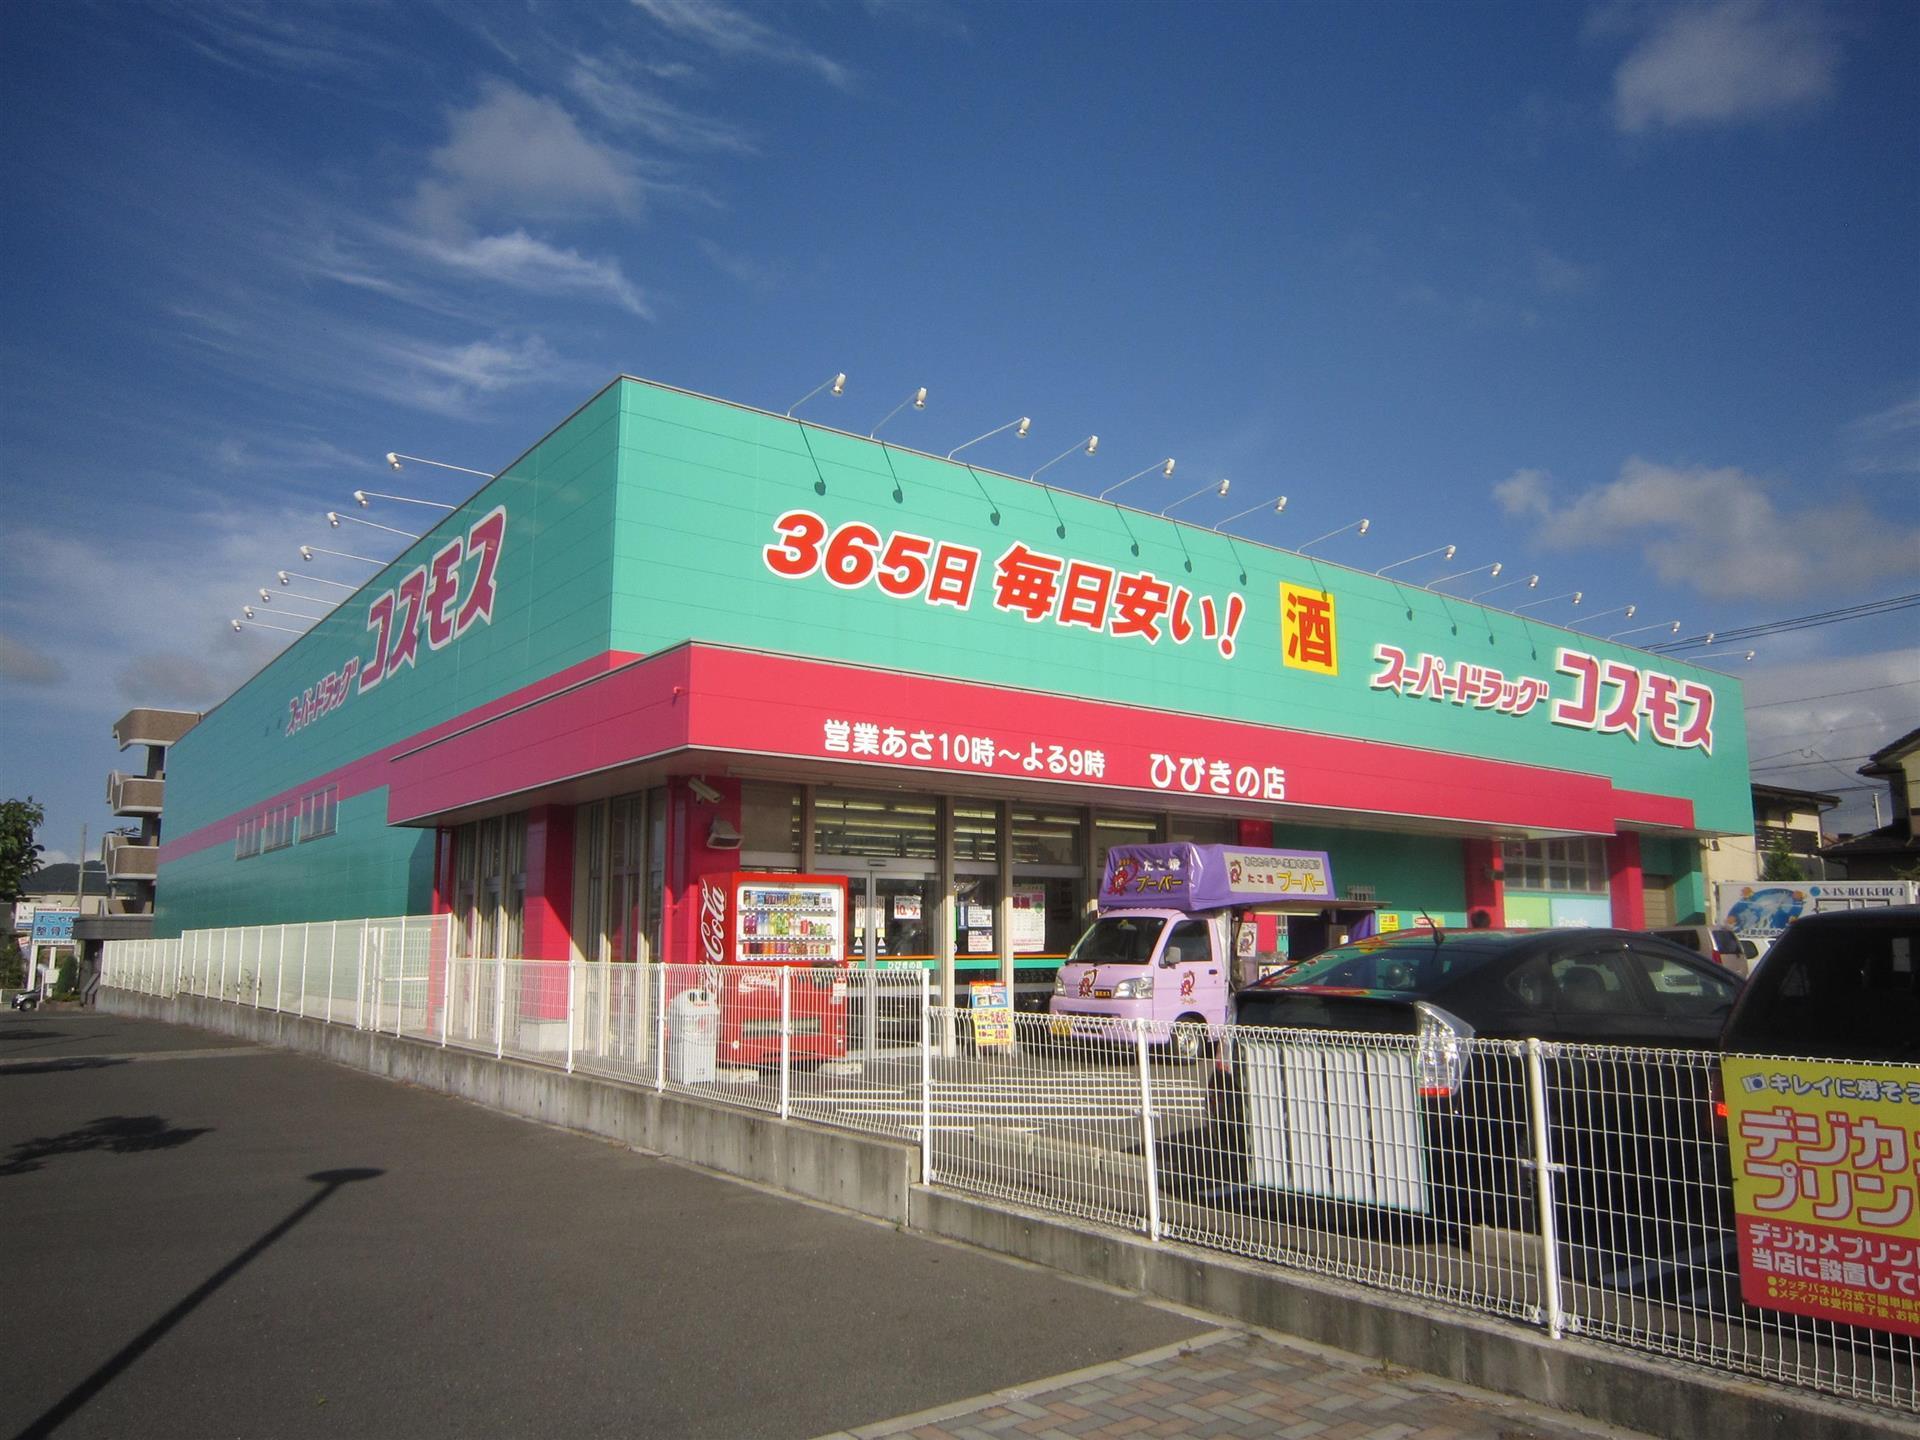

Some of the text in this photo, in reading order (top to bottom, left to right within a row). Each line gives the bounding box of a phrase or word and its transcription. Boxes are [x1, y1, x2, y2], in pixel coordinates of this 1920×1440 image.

[763, 509, 982, 611] 365日
[286, 505, 507, 737] スーパードラッグ コスモス
[1286, 591, 1333, 668] 酒
[1370, 643, 1715, 757] スーパードラッグ コスモス
[1149, 752, 1286, 800] ひびきの店
[1740, 1106, 1920, 1175] デジカ
[1752, 1248, 1920, 1296] 当店に設置して
